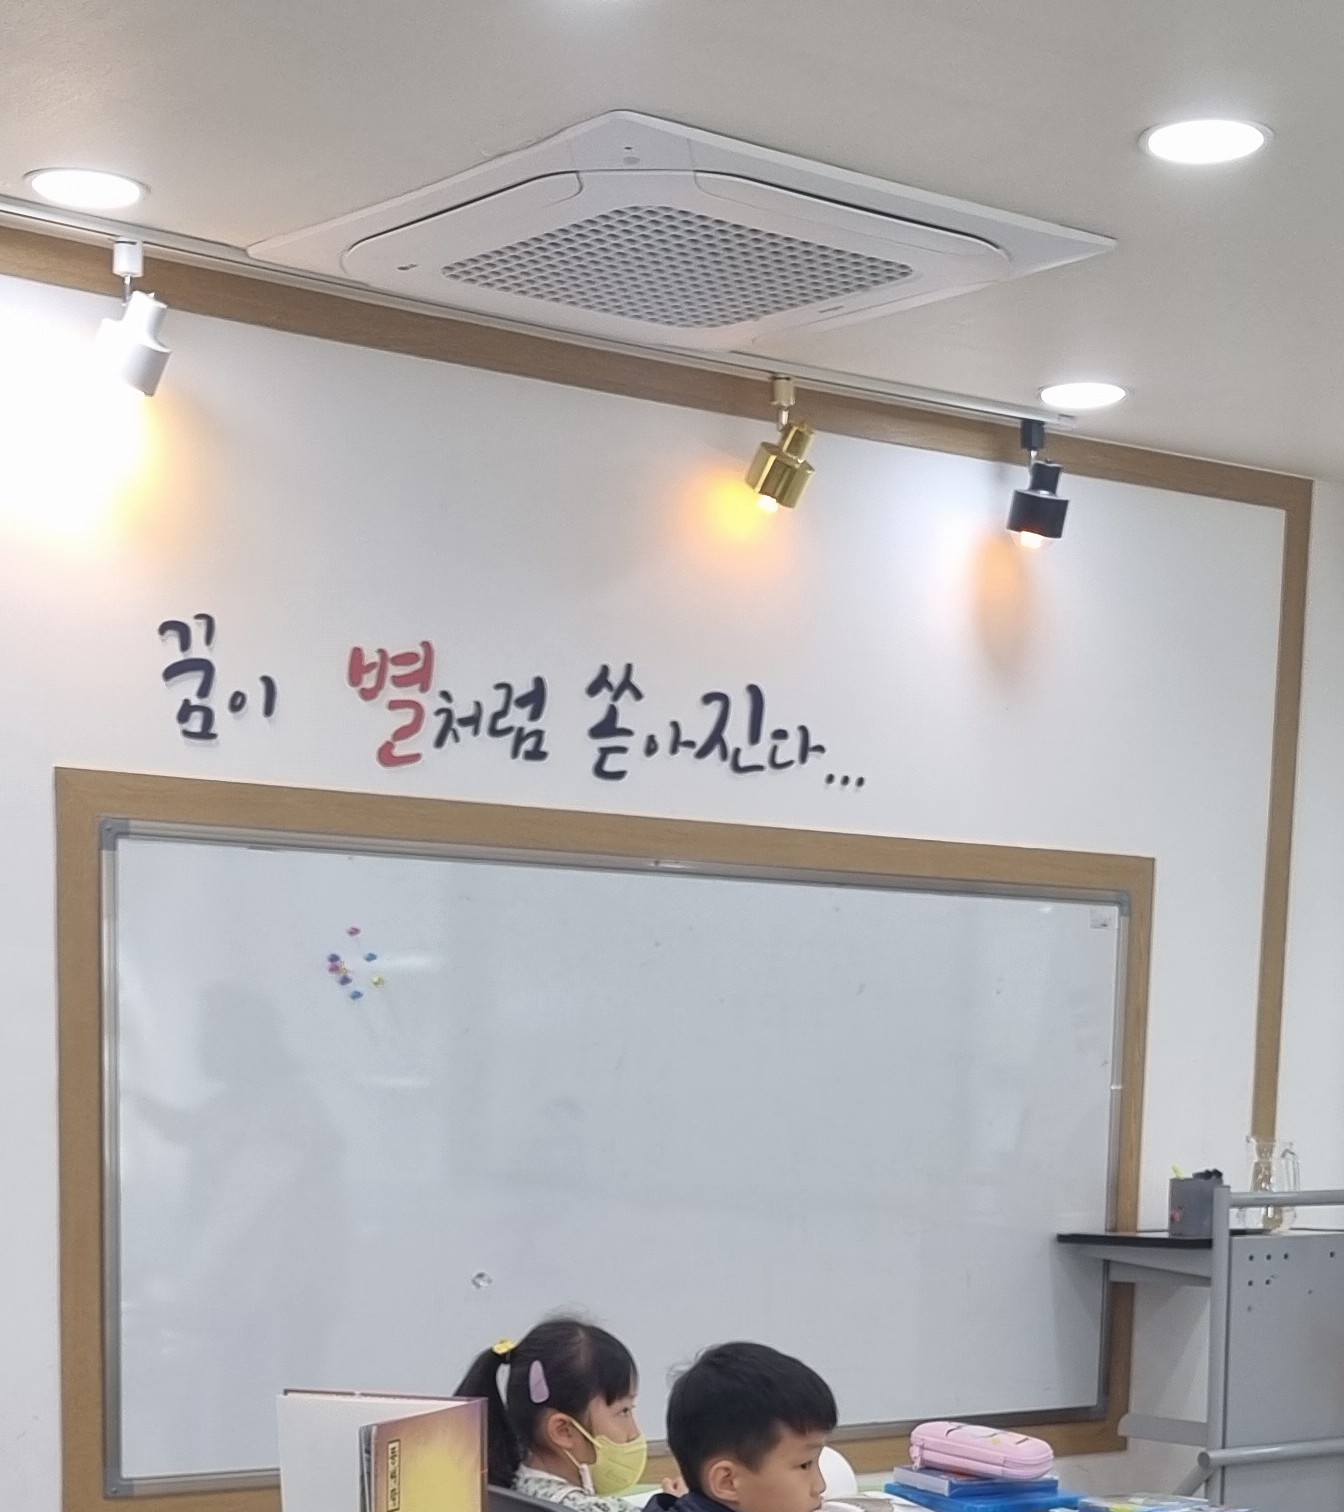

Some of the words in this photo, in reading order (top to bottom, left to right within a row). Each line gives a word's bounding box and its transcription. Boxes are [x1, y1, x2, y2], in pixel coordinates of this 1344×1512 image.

[157, 612, 278, 741] 꿈이
[346, 640, 549, 768] 별처럼
[585, 662, 866, 790] 쏟아진다...
